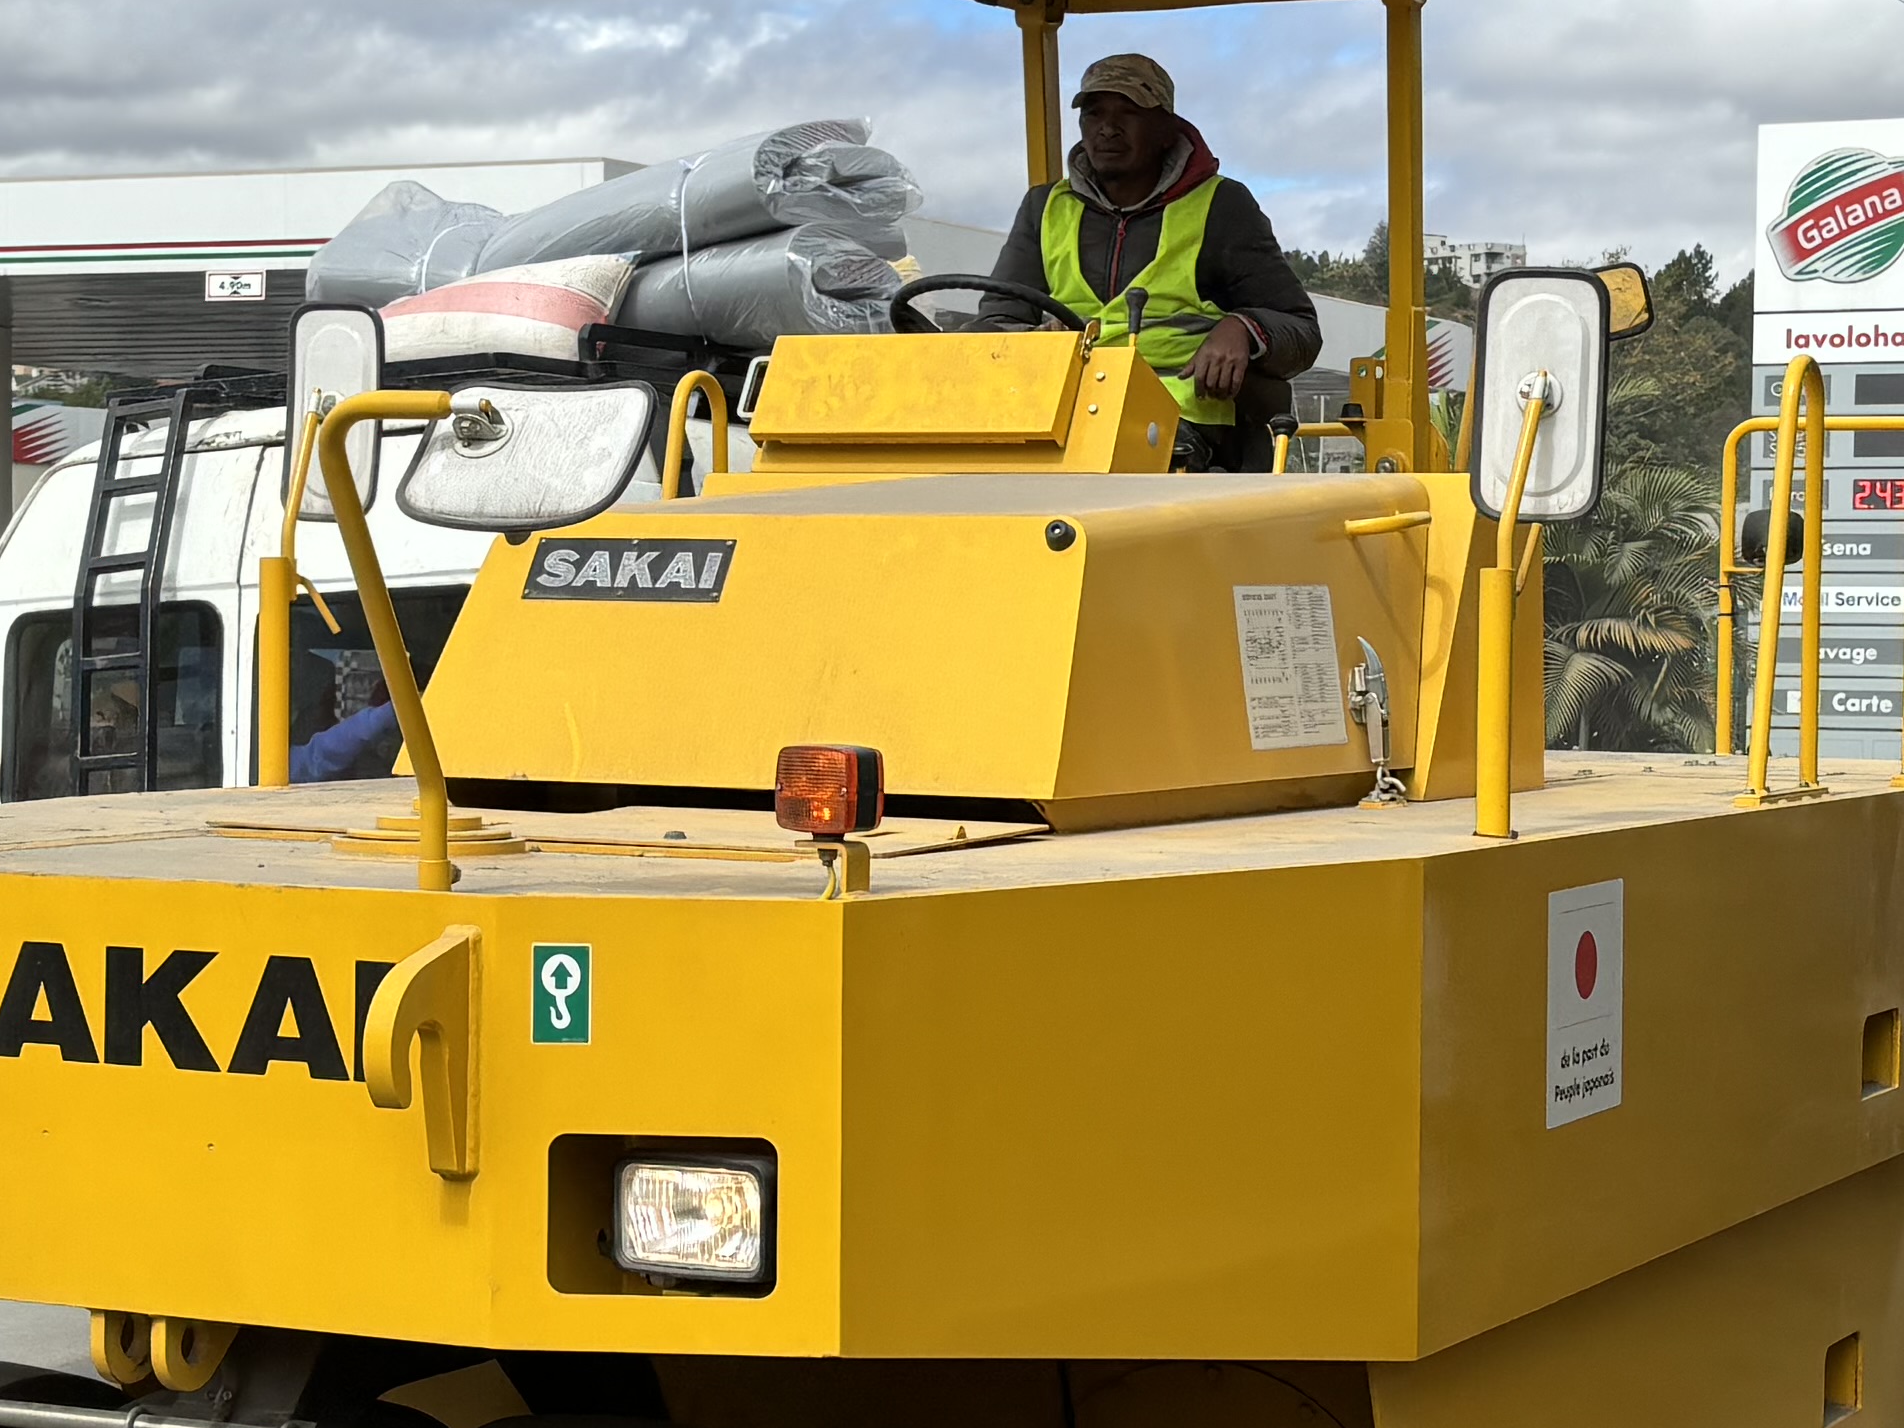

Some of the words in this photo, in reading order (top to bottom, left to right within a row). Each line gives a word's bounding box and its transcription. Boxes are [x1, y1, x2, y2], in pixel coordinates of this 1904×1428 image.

[1797, 186, 1903, 250] Galana
[1822, 538, 1872, 556] sena
[536, 549, 723, 589] SAKAI
[1835, 591, 1902, 607] Service
[1818, 646, 1878, 665] avage
[1832, 692, 1894, 713] Carte
